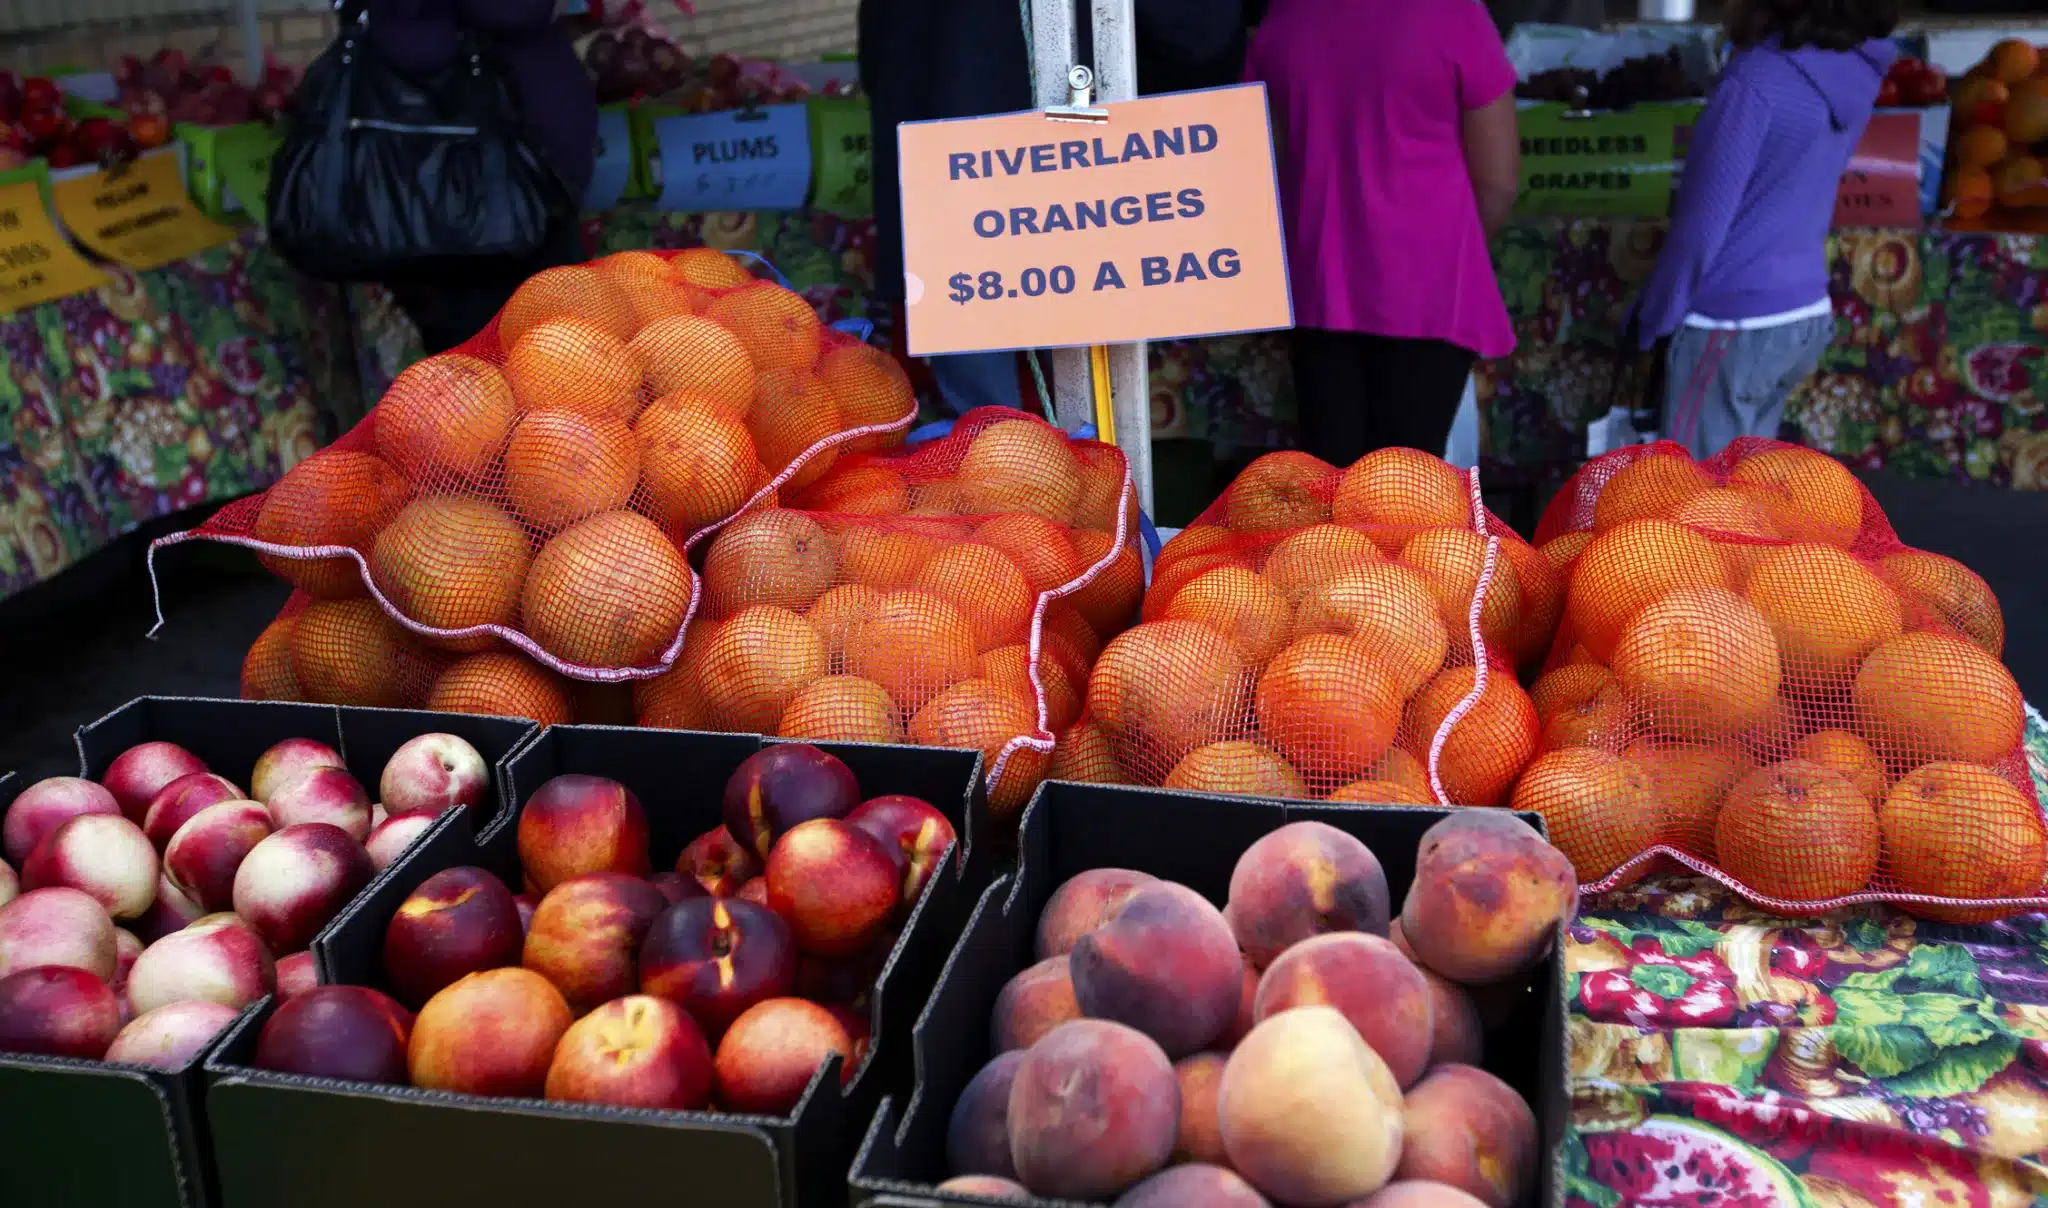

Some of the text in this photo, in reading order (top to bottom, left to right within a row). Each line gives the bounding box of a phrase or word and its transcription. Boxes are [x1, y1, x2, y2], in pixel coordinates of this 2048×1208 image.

[692, 135, 780, 165] PLUMS
[948, 123, 1219, 181] RIVERLAND
[1520, 135, 1646, 155] SEEDLESS
[1529, 173, 1632, 190] GRAPES
[973, 188, 1206, 238] ORANGES
[948, 248, 1242, 306] $8.00 A BAG
